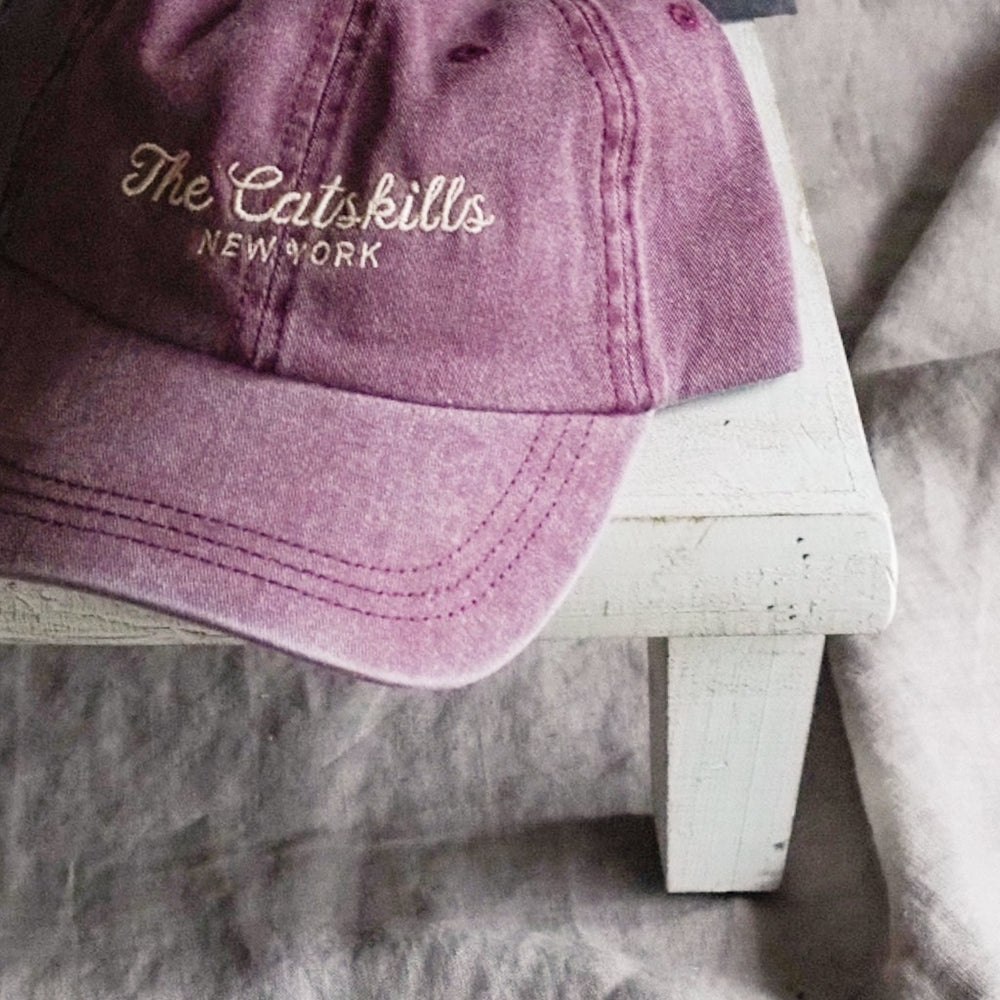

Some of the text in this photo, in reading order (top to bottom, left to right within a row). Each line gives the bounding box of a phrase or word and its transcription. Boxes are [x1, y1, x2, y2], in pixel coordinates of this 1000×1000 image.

[121, 142, 495, 233] The Catskills
[197, 228, 382, 269] NEW YORK
